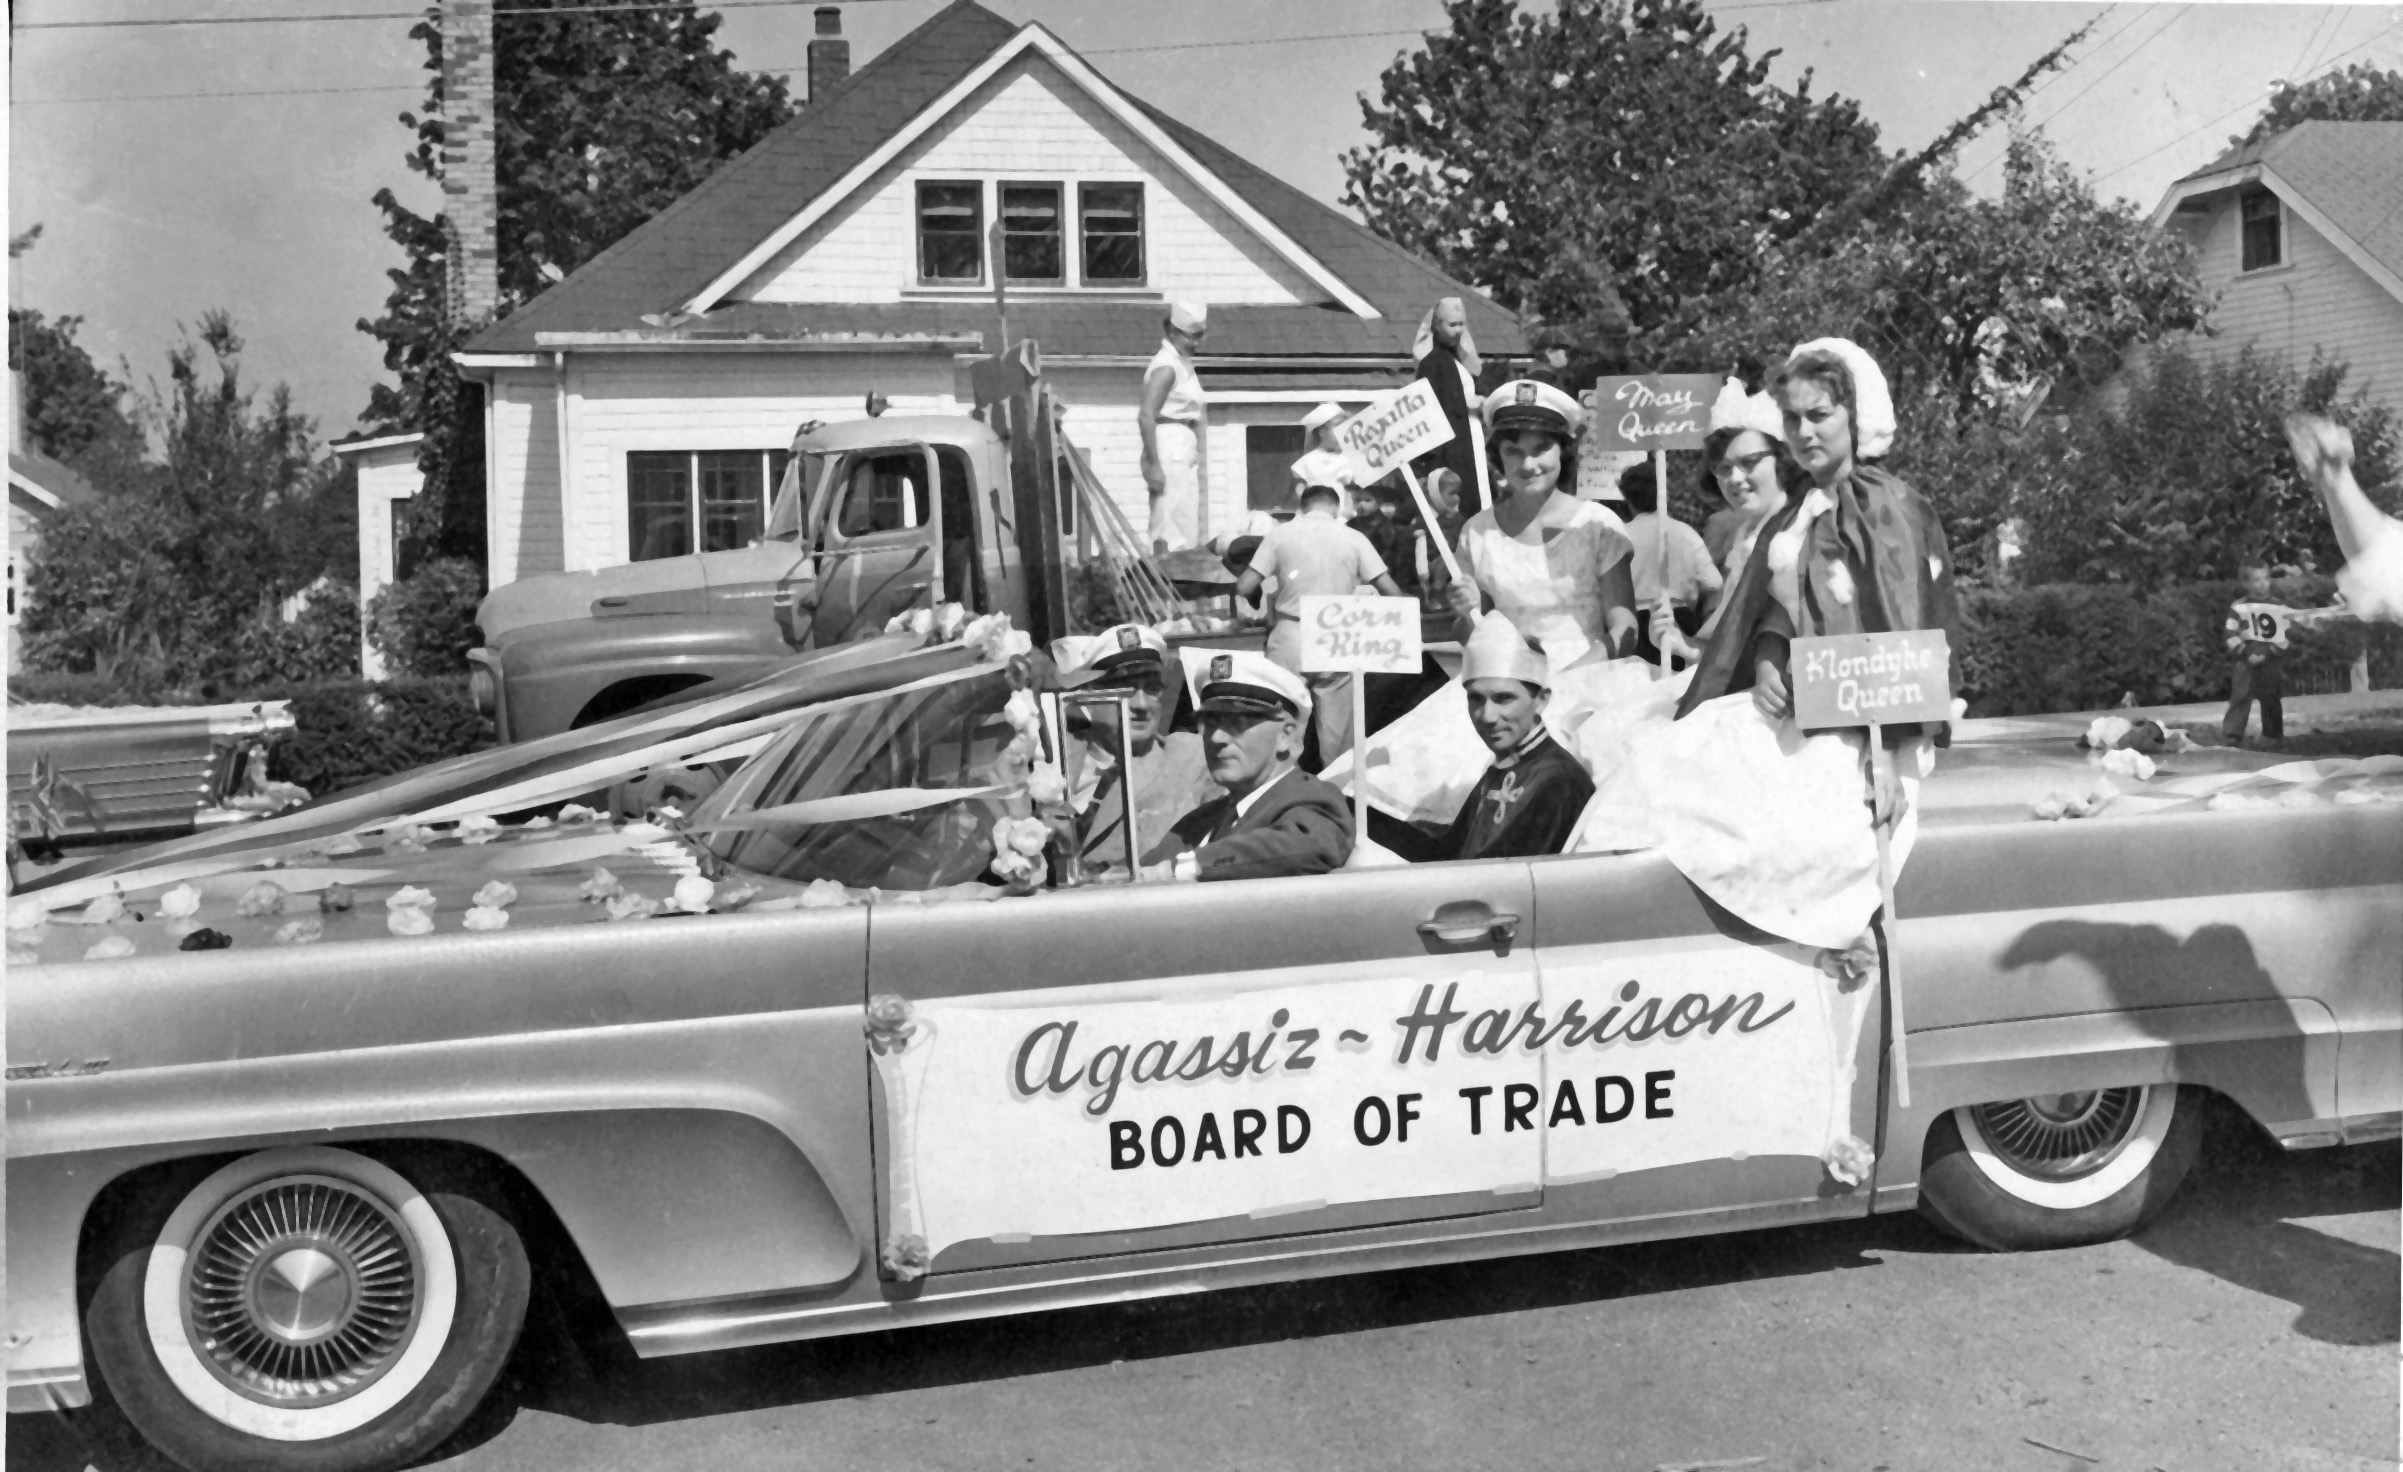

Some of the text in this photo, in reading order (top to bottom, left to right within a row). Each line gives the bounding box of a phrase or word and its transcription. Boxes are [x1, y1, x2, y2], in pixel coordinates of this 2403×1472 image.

[1615, 380, 1703, 414] May
[1343, 394, 1426, 450] Regatta
[1618, 411, 1704, 443] Queen
[1366, 420, 1431, 468] Queen
[1317, 603, 1402, 629] Corn
[2251, 612, 2277, 639] 19
[1315, 631, 1411, 669] King
[1838, 680, 1923, 717] Queen
[1013, 1008, 1320, 1117] Agassiz
[1396, 980, 1796, 1065] Harrison
[1111, 1069, 1677, 1170] BOARD OF TRADE
